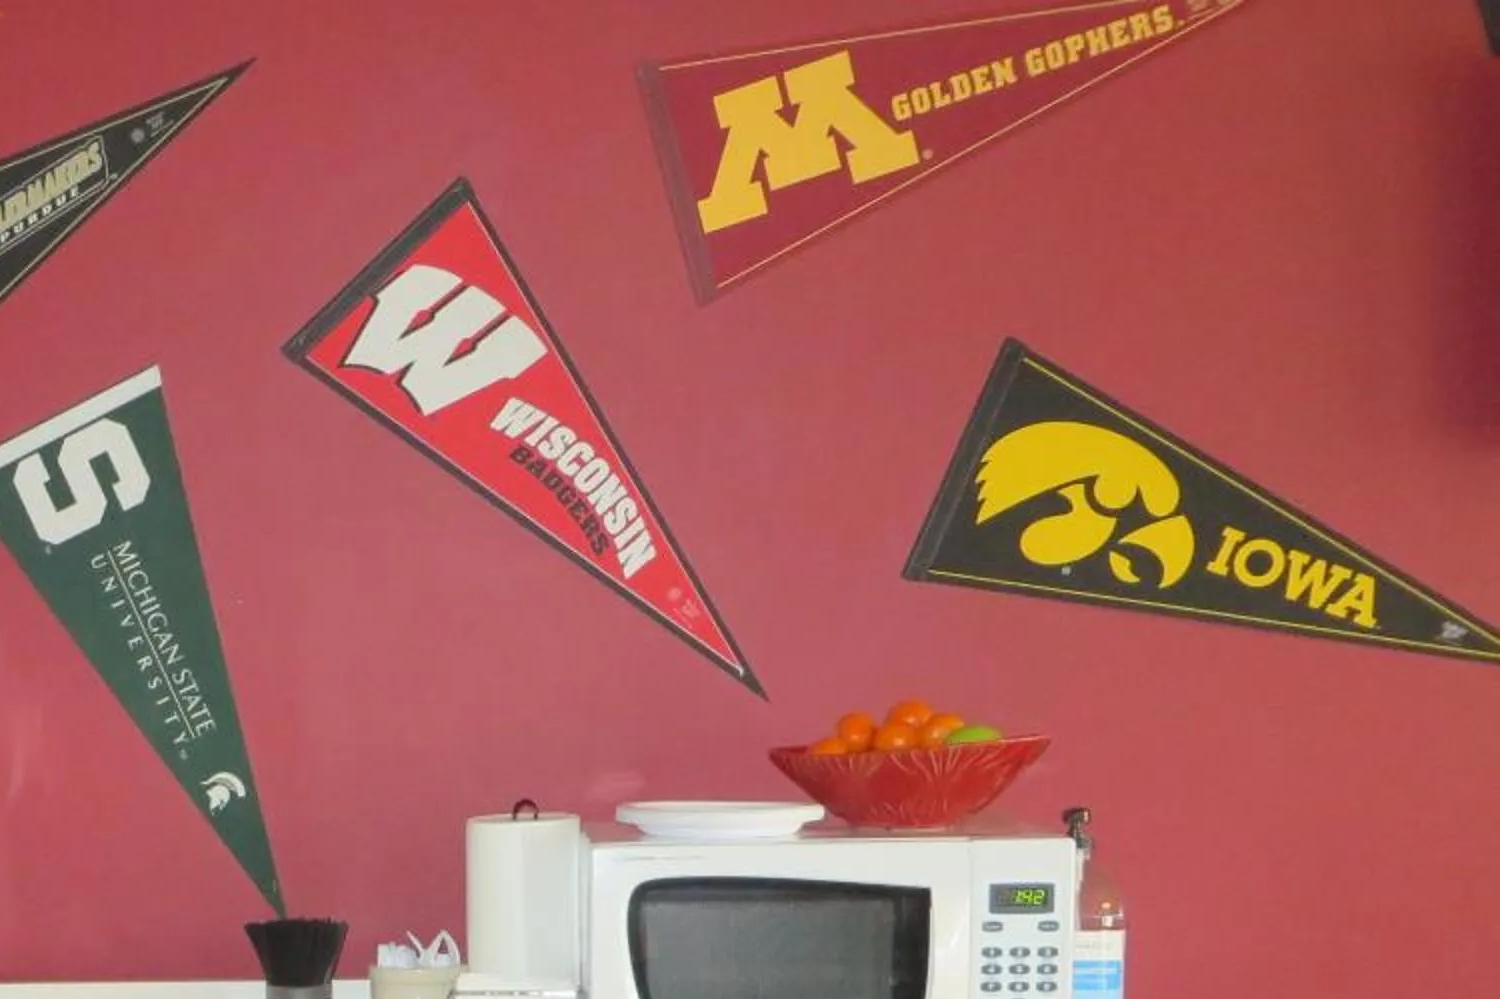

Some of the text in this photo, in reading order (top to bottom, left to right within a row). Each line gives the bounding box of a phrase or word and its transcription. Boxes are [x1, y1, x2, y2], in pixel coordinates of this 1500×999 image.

[890, 4, 1176, 121] GOLDEN GOPHERS
[0, 187, 80, 242] PURDUE
[340, 263, 549, 417] W
[12, 416, 151, 546] S
[490, 397, 657, 579] WISCONSIN
[508, 445, 611, 556] BADGERS
[112, 540, 216, 737] MICHIGAN STATE
[1207, 526, 1379, 629] IOWA
[89, 552, 190, 747] UNIVERSITY
